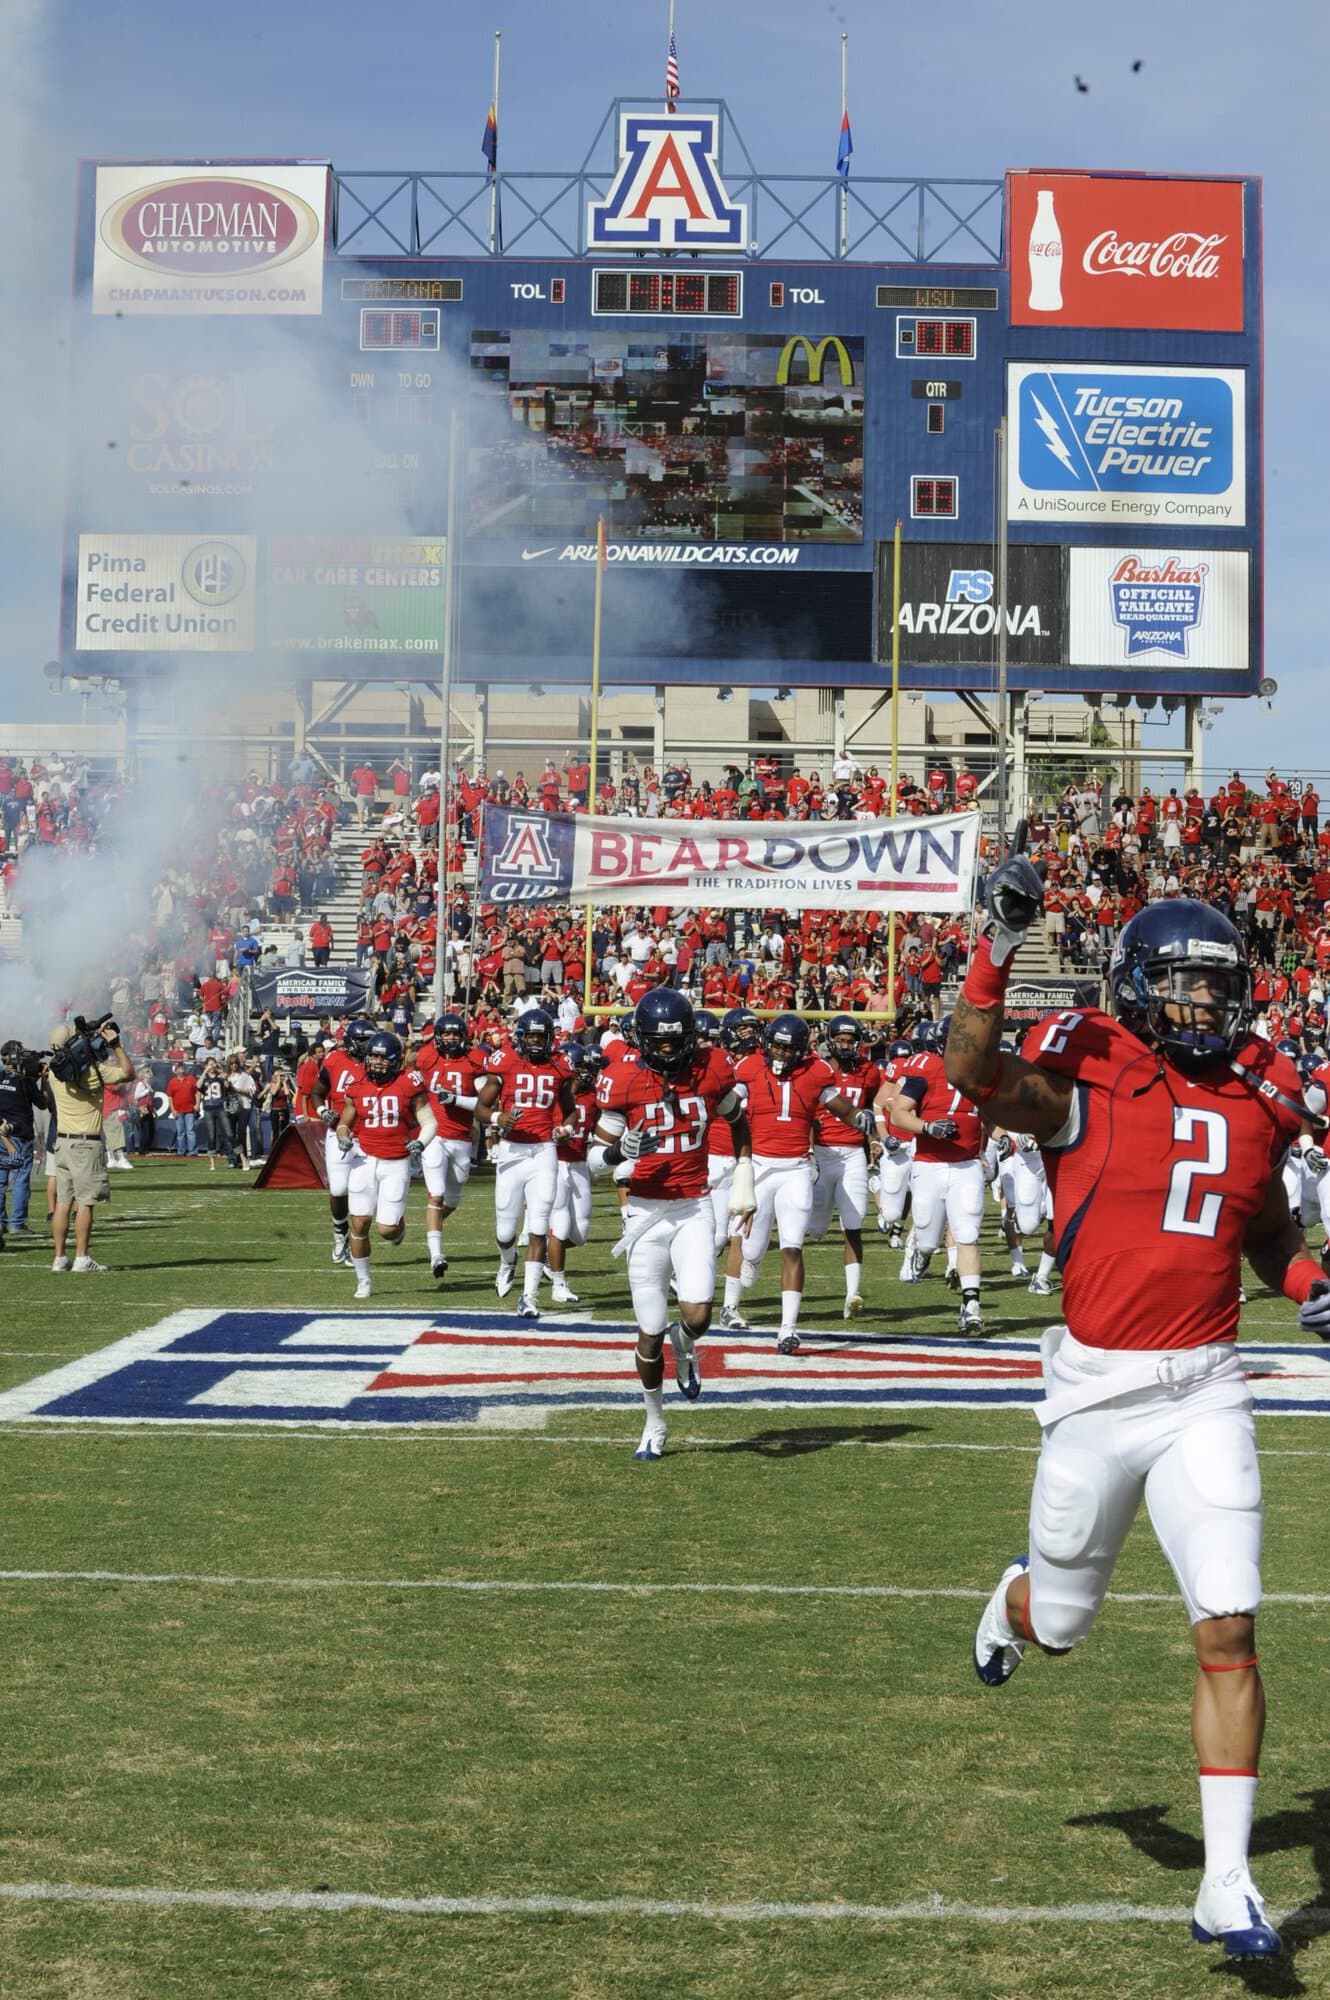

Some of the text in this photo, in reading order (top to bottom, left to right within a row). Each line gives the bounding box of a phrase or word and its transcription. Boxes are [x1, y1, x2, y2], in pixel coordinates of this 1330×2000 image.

[588, 113, 747, 249] A
[138, 202, 280, 238] CHAPMAN
[142, 240, 277, 253] AUTOMOTIVE
[1082, 229, 1229, 279] Coca-Cola
[108, 288, 306, 302] CHAPMANTUCSON.COM
[510, 284, 546, 299] TOL
[789, 288, 825, 304] TOL
[916, 289, 956, 307] WSU
[351, 373, 375, 388] DWN
[399, 373, 431, 389] TO GO
[926, 382, 947, 398] QTR
[1074, 388, 1184, 419] Tucson
[1085, 418, 1213, 448] Electric
[1097, 447, 1212, 477] Power
[1018, 498, 1233, 518] A UniSource Energy Company
[87, 552, 147, 573] Pima
[314, 567, 359, 585] CARE
[365, 568, 440, 587] CENTERS
[945, 570, 994, 603] FS
[86, 581, 175, 603] Federal
[1119, 588, 1195, 601] OFFICIAL
[1119, 601, 1194, 613] TAILGATE
[1119, 613, 1194, 622] HEADQUARTERS
[85, 612, 238, 634] Credit Union
[890, 603, 1041, 636] ARIZONA
[1132, 631, 1181, 641] ARIZONA
[491, 814, 560, 881] A
[588, 829, 965, 877] BEAR DOWN
[694, 877, 852, 890] THE TRADITION LIVES
[277, 979, 346, 987] AMERICAN FAMILY
[1047, 992, 1074, 1000] FAMILY
[1041, 1012, 1084, 1054] 2
[515, 1073, 555, 1110] 26
[776, 1080, 792, 1121] 1
[362, 1095, 400, 1128] 38
[645, 1096, 708, 1154] 23
[1162, 1106, 1229, 1239] 2
